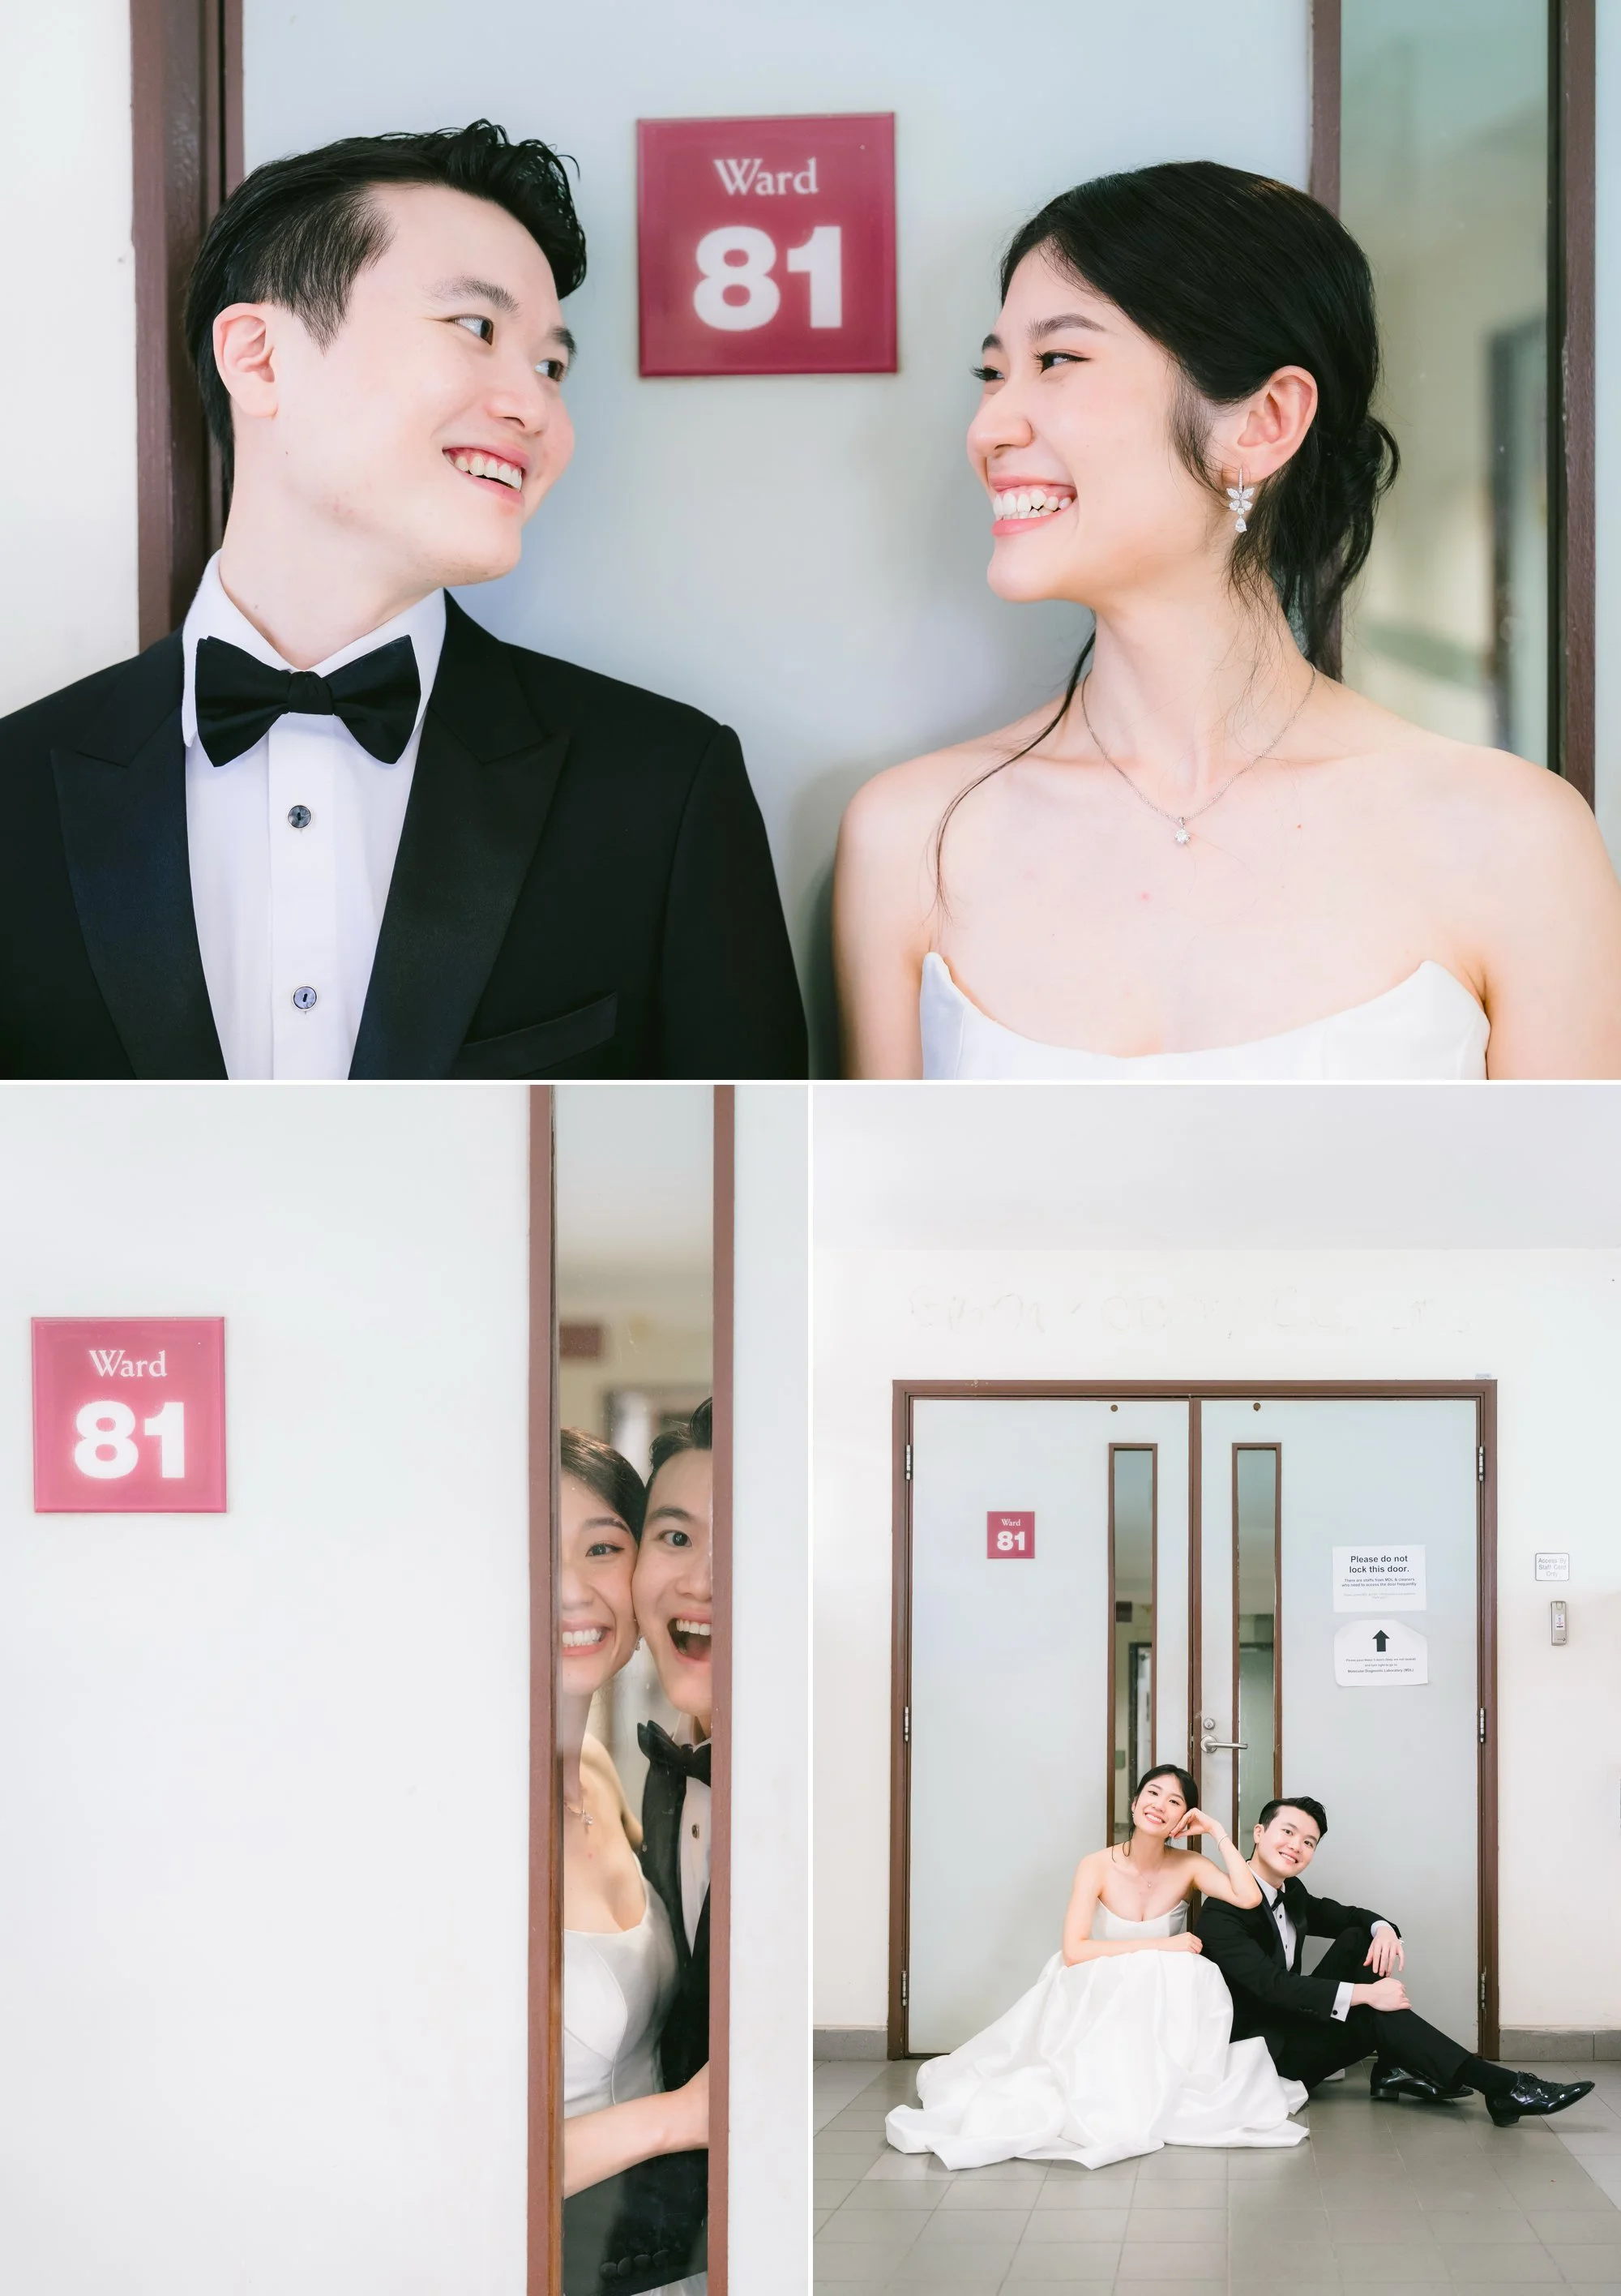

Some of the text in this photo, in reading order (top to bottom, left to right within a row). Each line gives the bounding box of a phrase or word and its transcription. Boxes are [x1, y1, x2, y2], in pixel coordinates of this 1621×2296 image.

[714, 157, 819, 195] Ward
[693, 225, 842, 332] 81
[88, 1349, 168, 1377] Ward
[74, 1400, 185, 1480] 81
[1001, 1518, 1021, 1527] Ward
[997, 1531, 1025, 1551] 81
[1349, 1565, 1409, 1574] lock this door.
